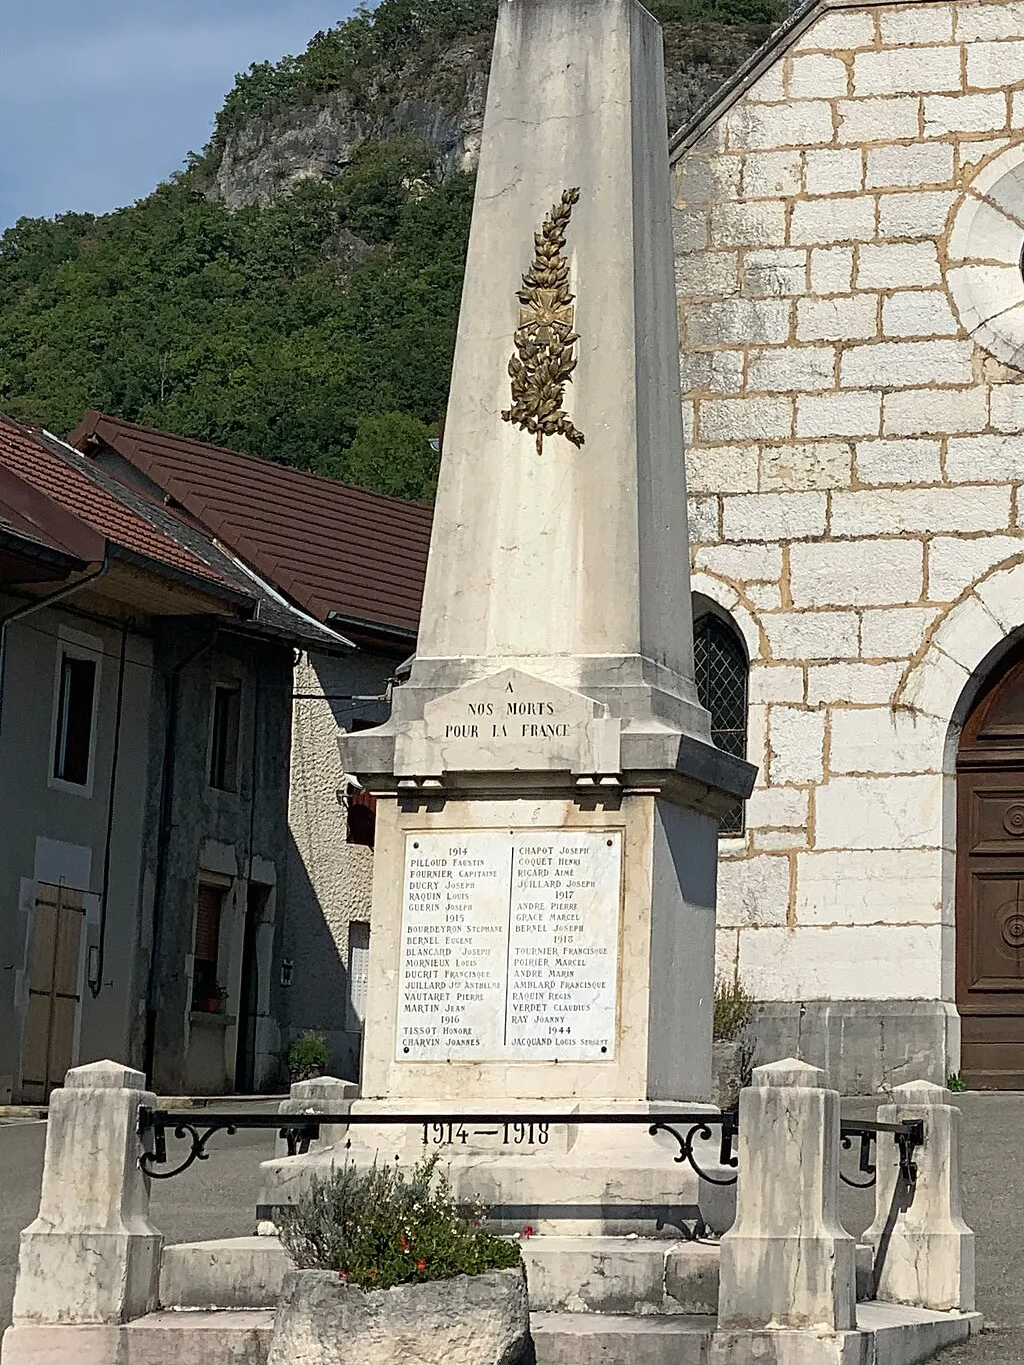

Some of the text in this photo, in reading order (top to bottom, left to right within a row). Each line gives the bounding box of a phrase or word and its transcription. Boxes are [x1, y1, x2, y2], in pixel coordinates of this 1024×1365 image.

[504, 681, 514, 693] A
[467, 702, 554, 715] NOS MORTS
[445, 724, 570, 738] POUR LA FRANCE
[449, 848, 468, 856] 1914
[519, 847, 554, 855] CHAPOT
[519, 858, 553, 867] COQUET
[409, 893, 441, 901] RAQUIN
[555, 891, 574, 899] 1917
[406, 948, 452, 956] BLANCARD
[405, 960, 450, 968] MORNIEUX
[405, 971, 438, 979] DUCRIT
[513, 982, 555, 990] AMBLARD
[404, 993, 450, 1002] VAUTARET
[404, 1004, 440, 1013] MARTIN
[513, 1004, 547, 1012] VERDET
[441, 1016, 460, 1024] 1916
[511, 1016, 528, 1024] RAY
[548, 1027, 571, 1035] 1944
[511, 1038, 552, 1047] JACQUAND
